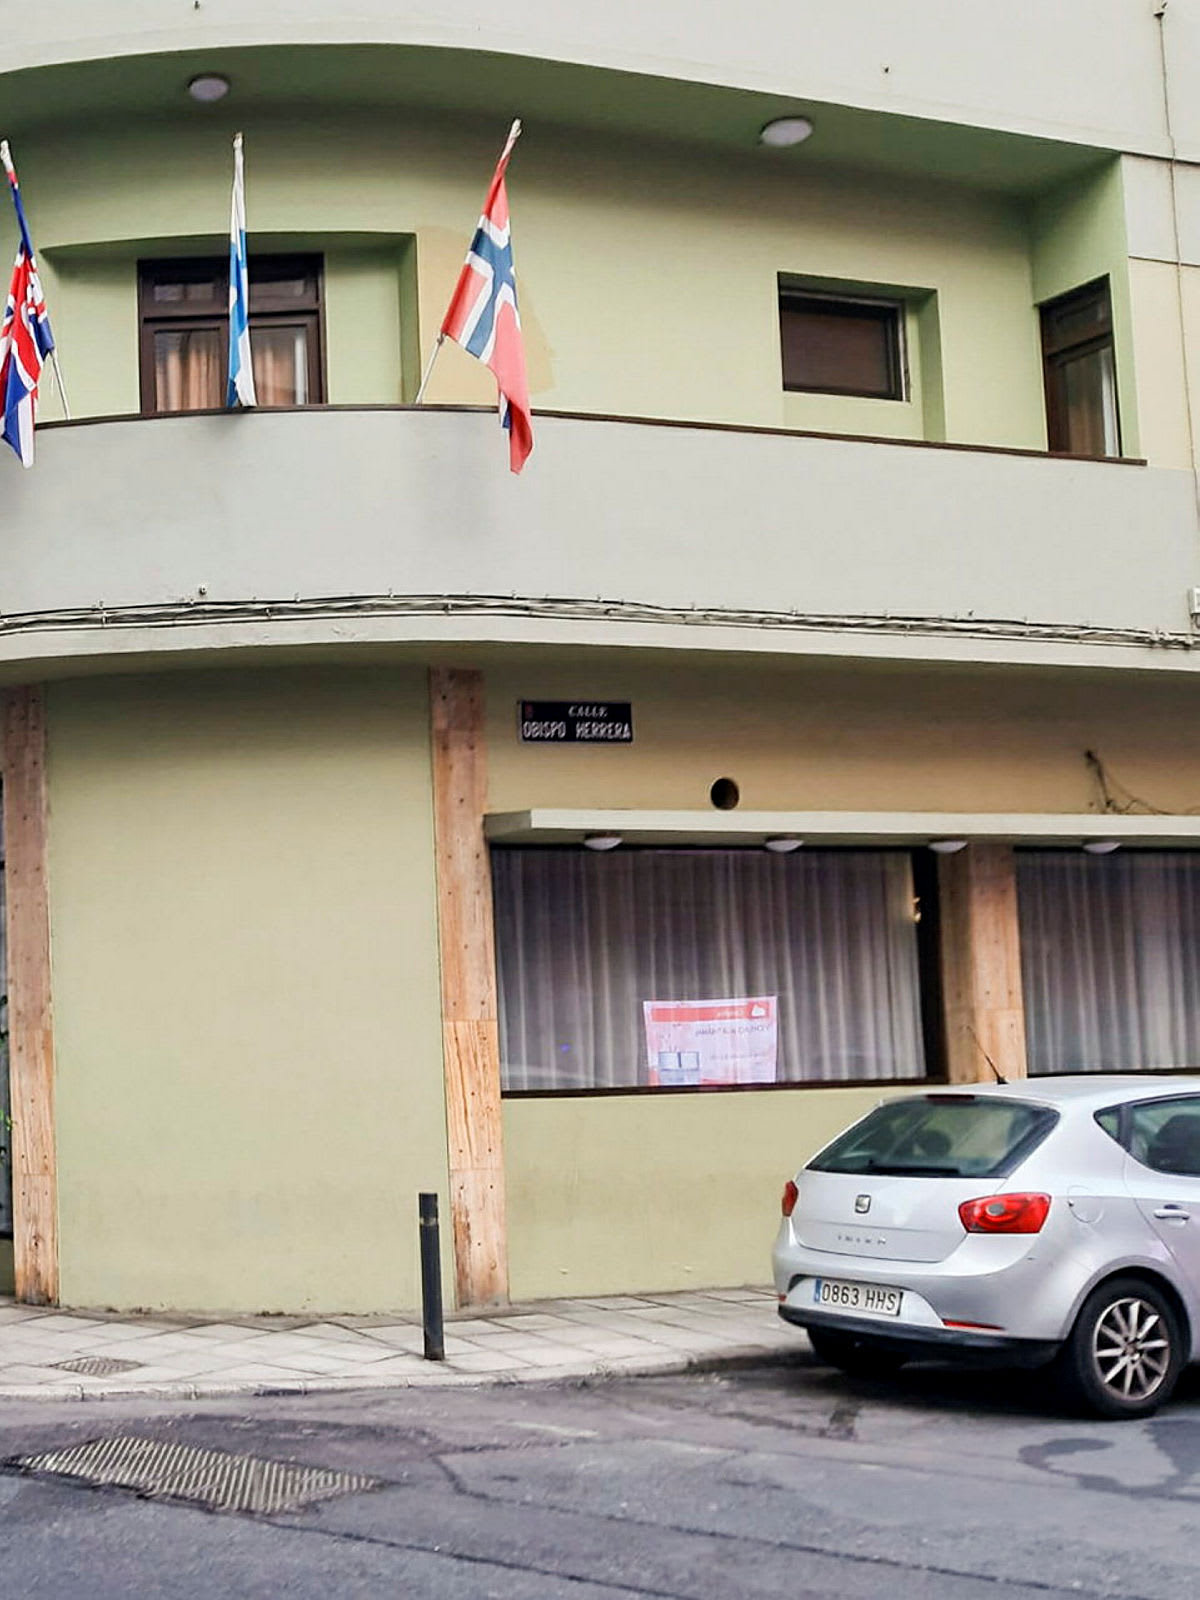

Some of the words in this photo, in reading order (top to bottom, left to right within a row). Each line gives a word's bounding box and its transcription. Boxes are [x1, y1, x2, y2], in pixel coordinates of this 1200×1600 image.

[567, 705, 608, 718] CALLE
[523, 721, 567, 738] OBISPO
[575, 722, 631, 739] HERRERA
[821, 1283, 860, 1306] 0863
[864, 1288, 898, 1311] HHS
